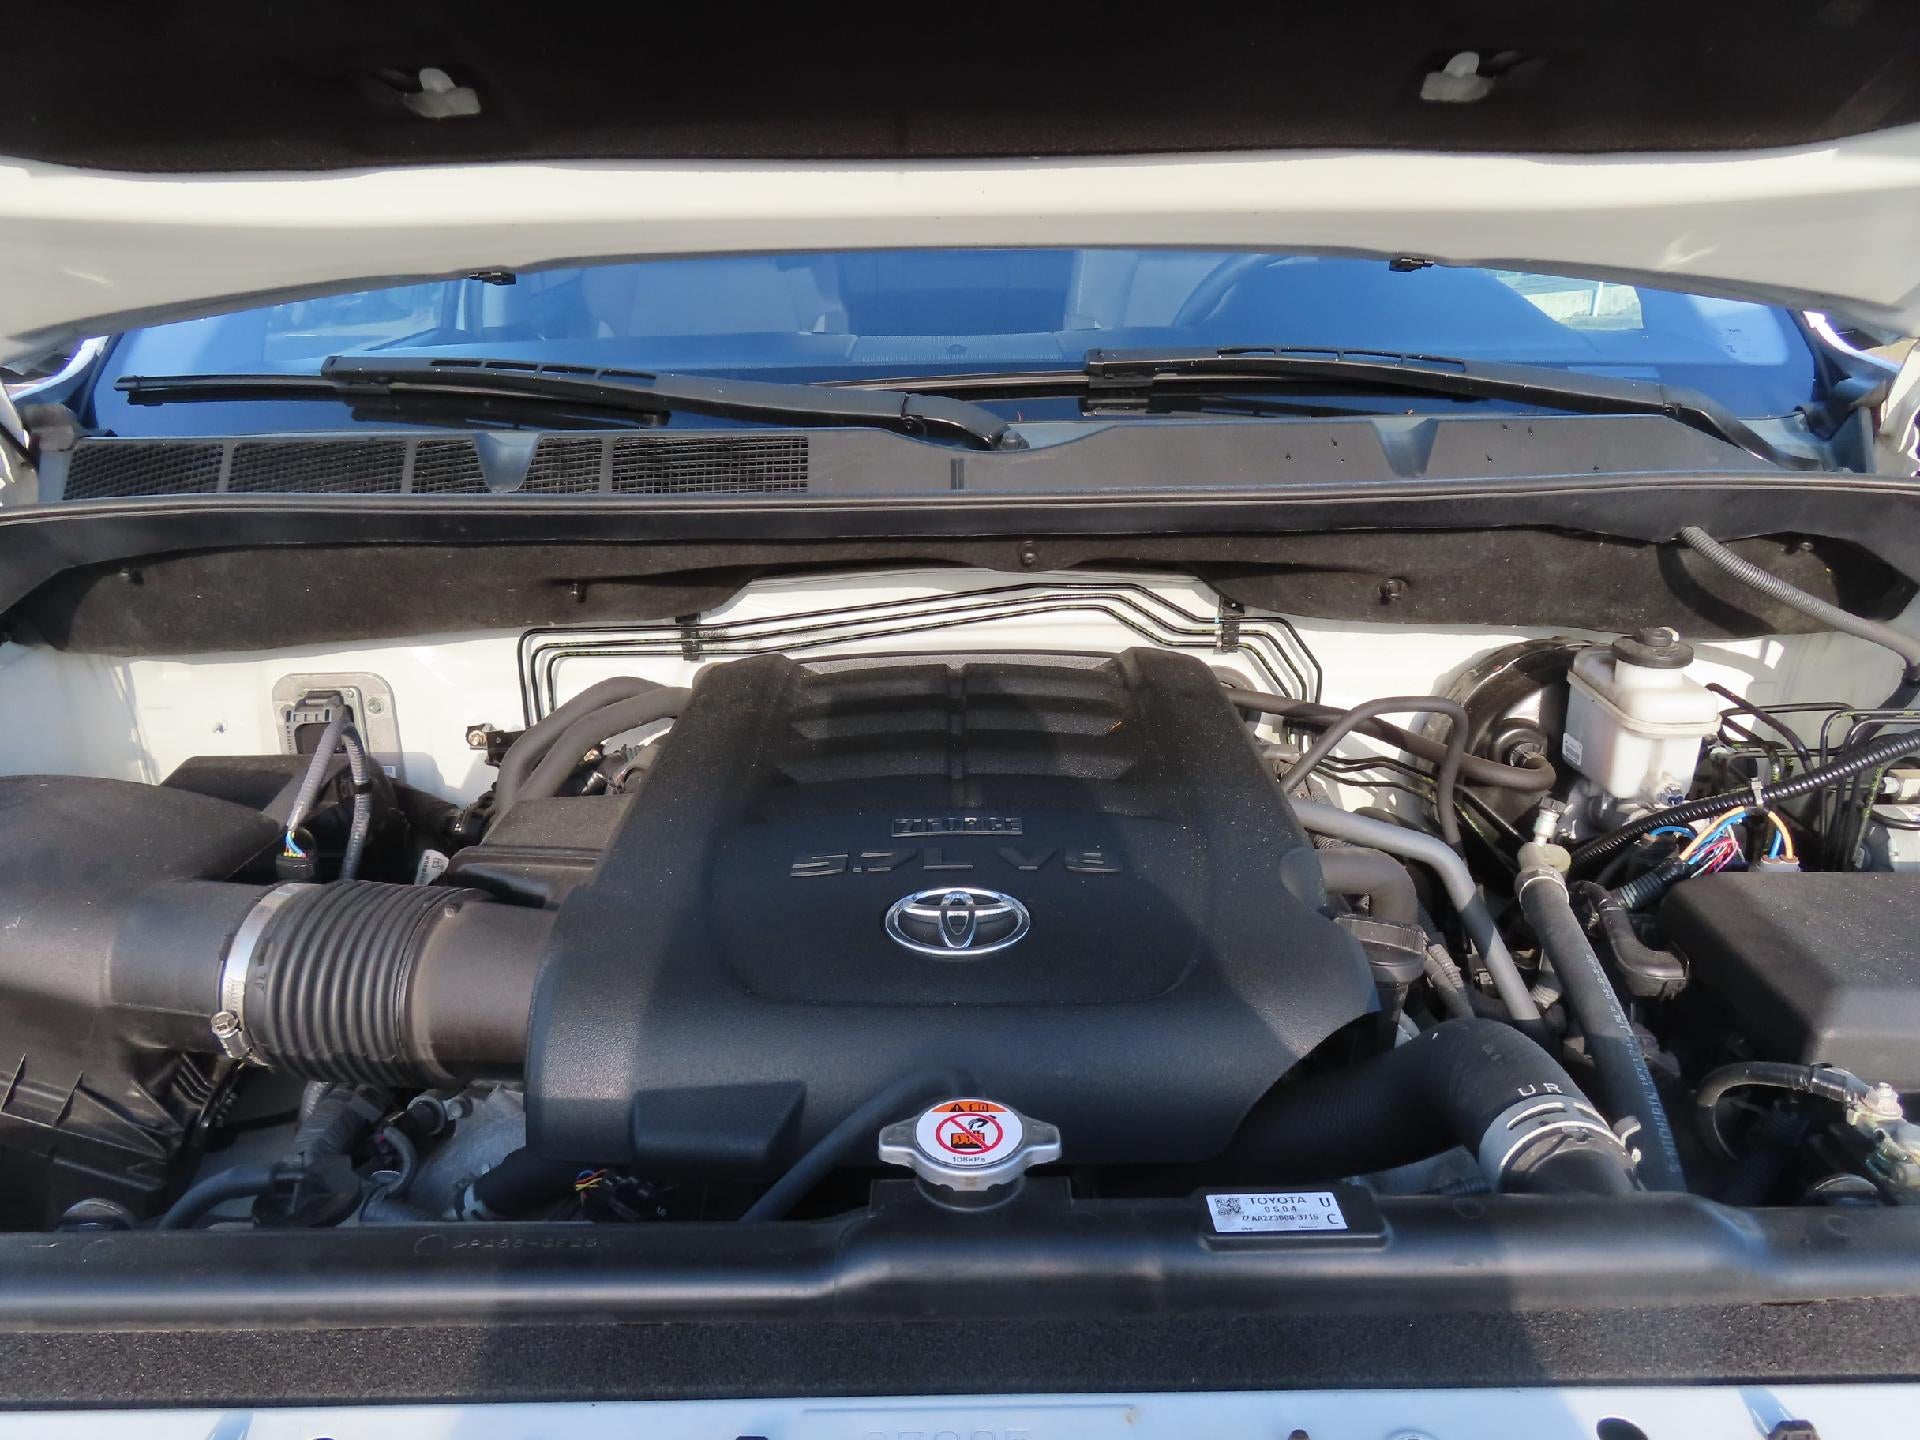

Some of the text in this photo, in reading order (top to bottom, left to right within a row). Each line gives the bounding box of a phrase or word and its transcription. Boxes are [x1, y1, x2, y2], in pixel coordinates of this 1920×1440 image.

[790, 847, 1123, 877] 5.7L V8
[1248, 1196, 1307, 1205] TOYOTA
[1318, 1197, 1331, 1208] U
[1327, 1213, 1339, 1225] C
